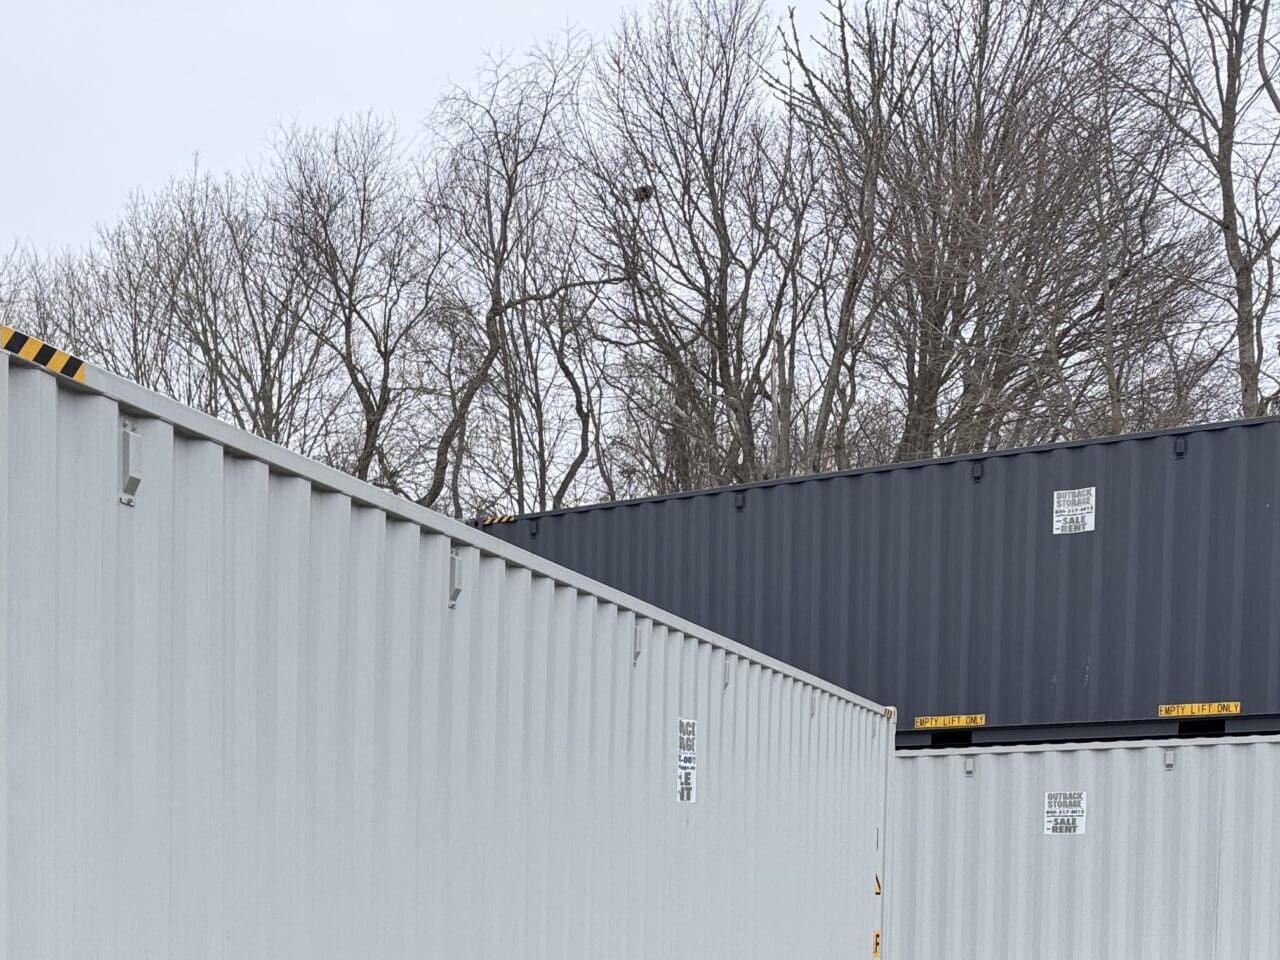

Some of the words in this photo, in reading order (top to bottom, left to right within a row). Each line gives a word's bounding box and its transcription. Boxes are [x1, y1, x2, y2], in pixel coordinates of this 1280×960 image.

[1062, 515, 1086, 525] SALE
[1061, 523, 1087, 533] RENT
[1159, 705, 1186, 716] EMPTY
[1191, 704, 1213, 714] LIFT
[1217, 703, 1239, 713] ONLY
[915, 717, 938, 727] EMPTY
[944, 716, 960, 726] LIFT
[965, 715, 984, 725] ONLY
[1047, 792, 1083, 801] OUTBACK
[1048, 800, 1082, 808] STORAGE
[1053, 818, 1077, 826] SALE
[1052, 825, 1078, 834] RENT
